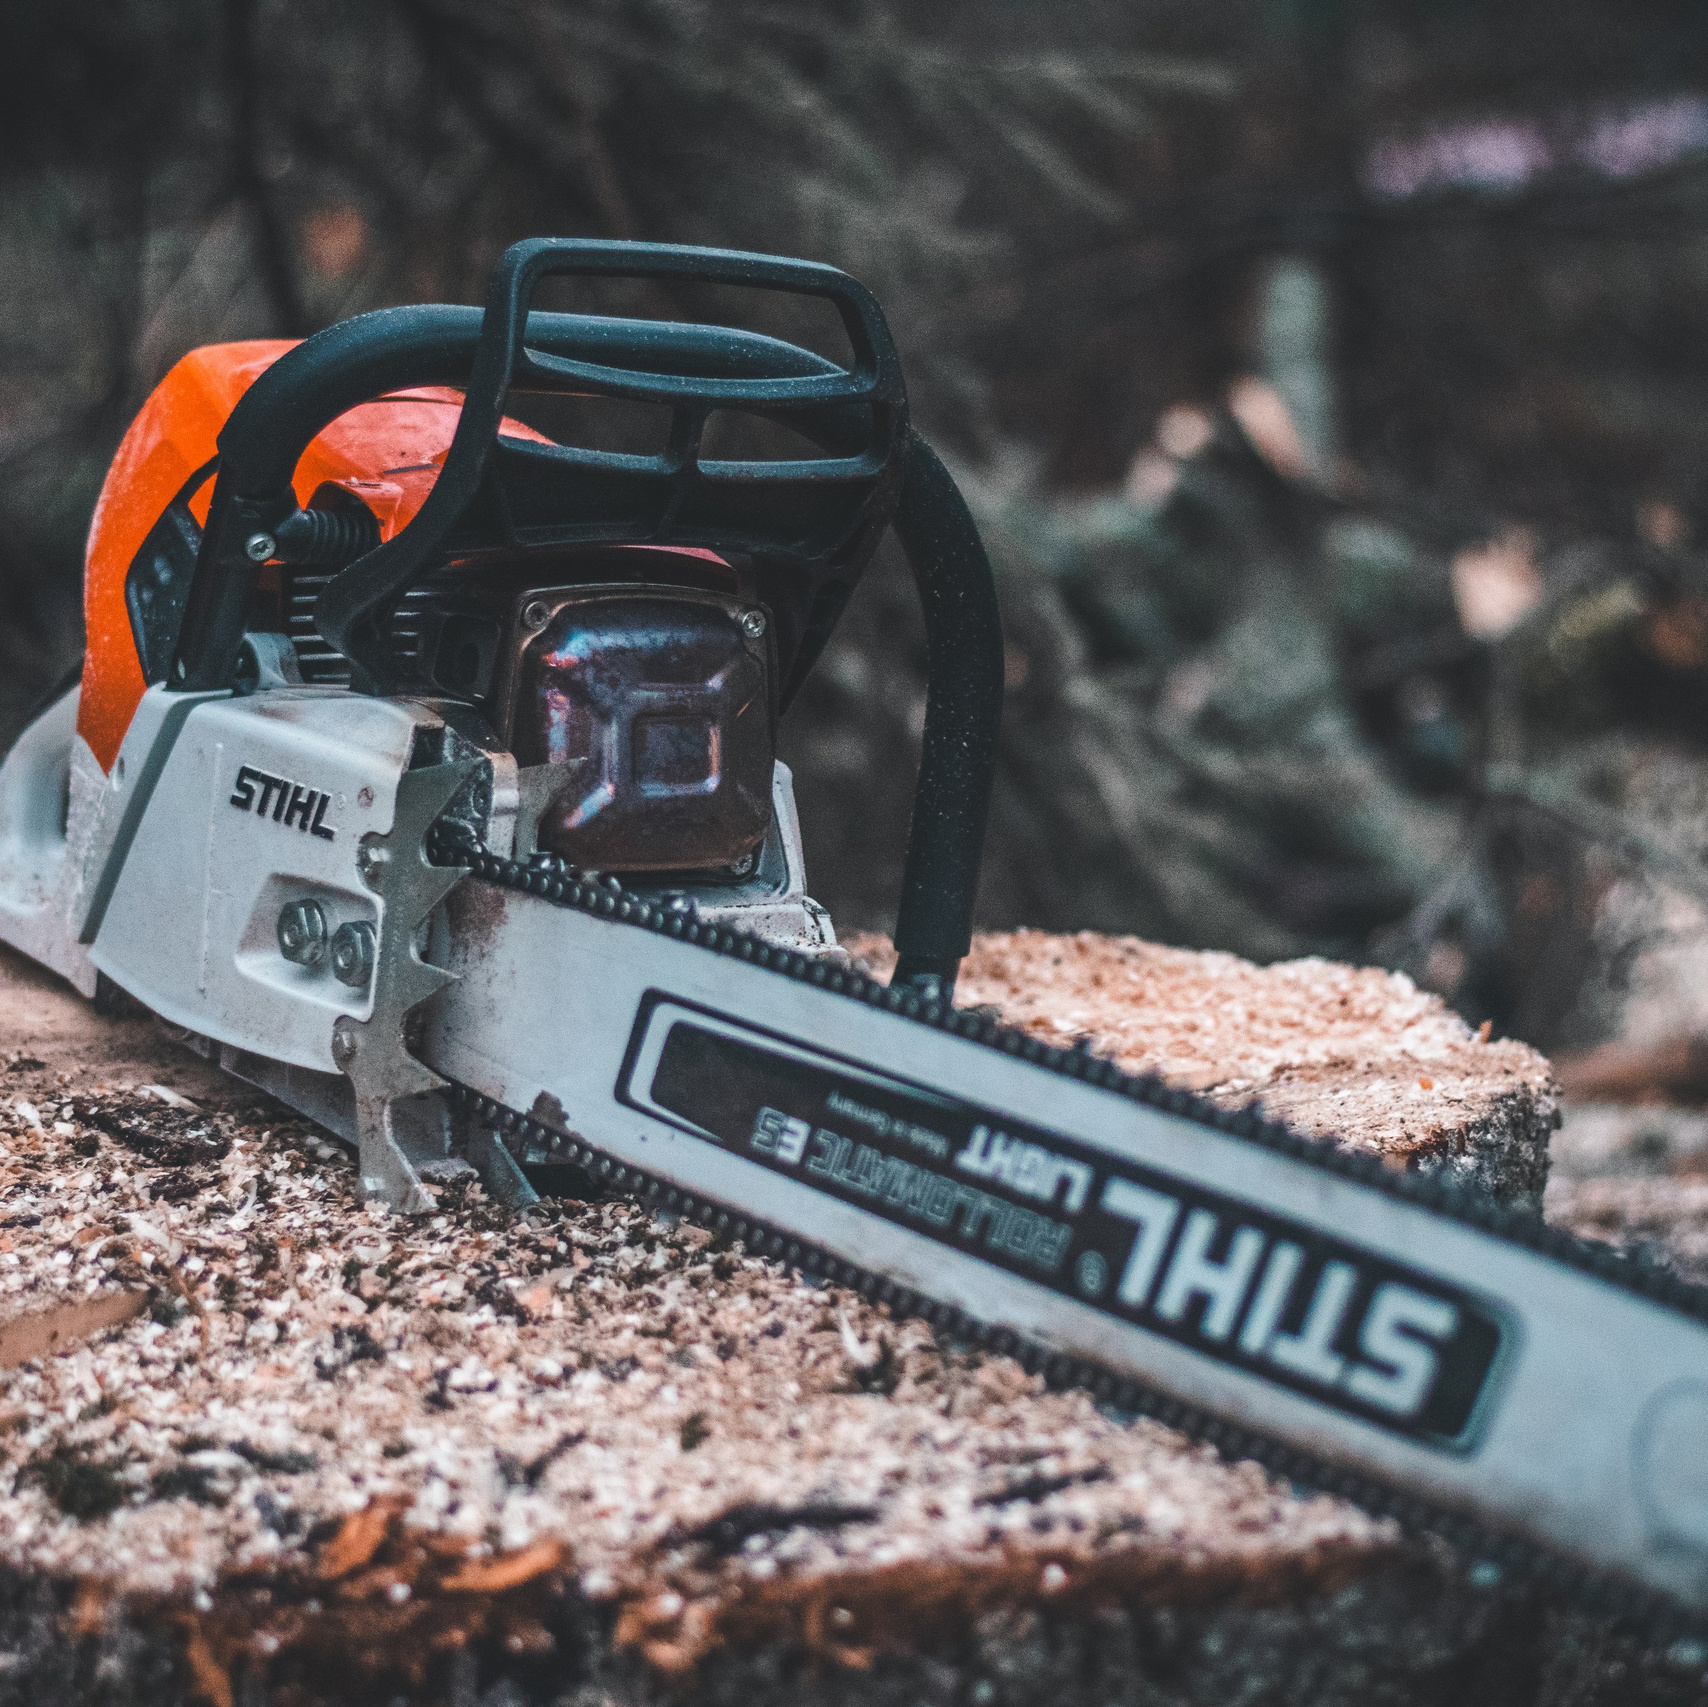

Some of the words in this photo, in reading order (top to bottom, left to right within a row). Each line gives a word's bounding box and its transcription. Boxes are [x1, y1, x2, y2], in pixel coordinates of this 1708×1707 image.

[230, 764, 337, 841] STIHL
[751, 1105, 812, 1166] ES
[953, 1124, 1094, 1214] LIGHT
[805, 1127, 1074, 1271] ROLLOMATIC
[1101, 1173, 1458, 1417] STIHL
